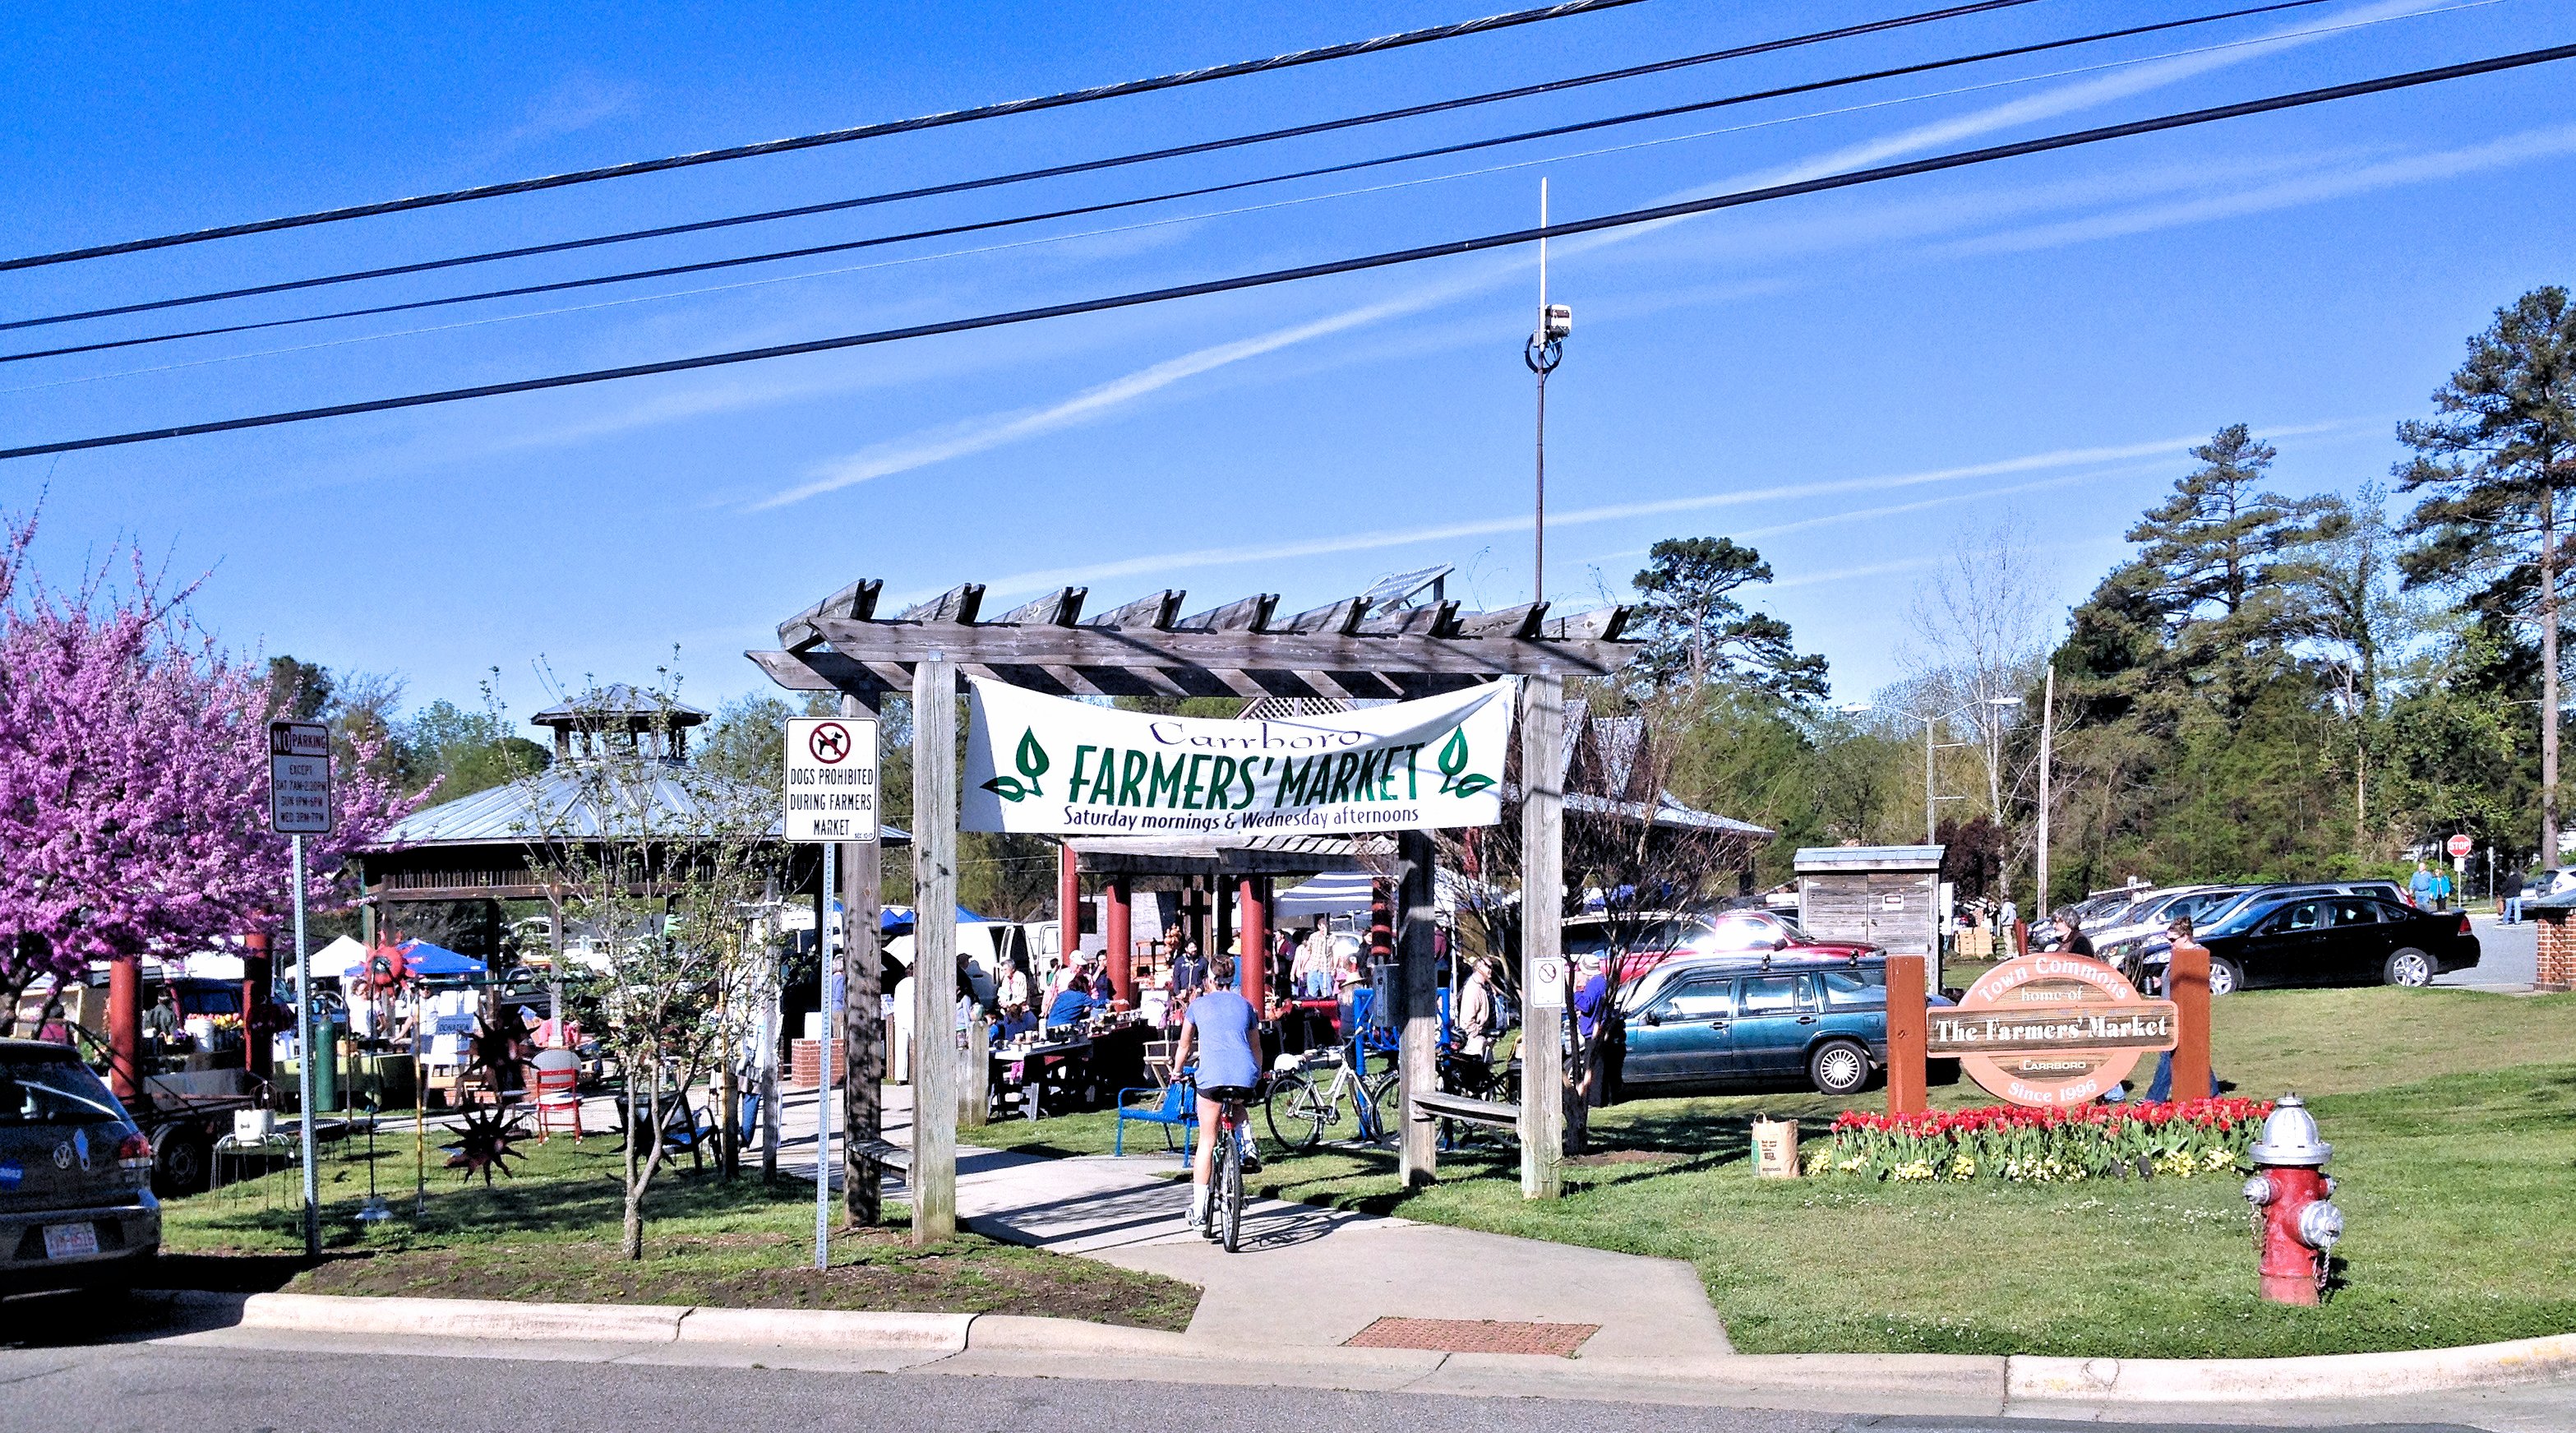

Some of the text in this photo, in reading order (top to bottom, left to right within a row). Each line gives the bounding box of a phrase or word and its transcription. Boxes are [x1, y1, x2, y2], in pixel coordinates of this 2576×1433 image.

[274, 730, 326, 751] NO PARKING
[1149, 722, 1361, 749] Carrboro
[289, 765, 312, 775] EXCEPT
[791, 769, 874, 785] DOGS PROHIBITED
[1069, 742, 1426, 810] FARMERS' MARKET
[790, 794, 872, 811] DURING FARMERS
[814, 820, 850, 836] MARKET
[1064, 806, 1420, 832] Saturday mornings & Wednesday afternoons
[2449, 841, 2470, 850] STOP
[1978, 957, 2128, 1003] Town Commons
[2021, 986, 2084, 1002] home of
[1935, 1015, 2168, 1042] The Farmers' Market
[2008, 1079, 2098, 1102] Since 1996
